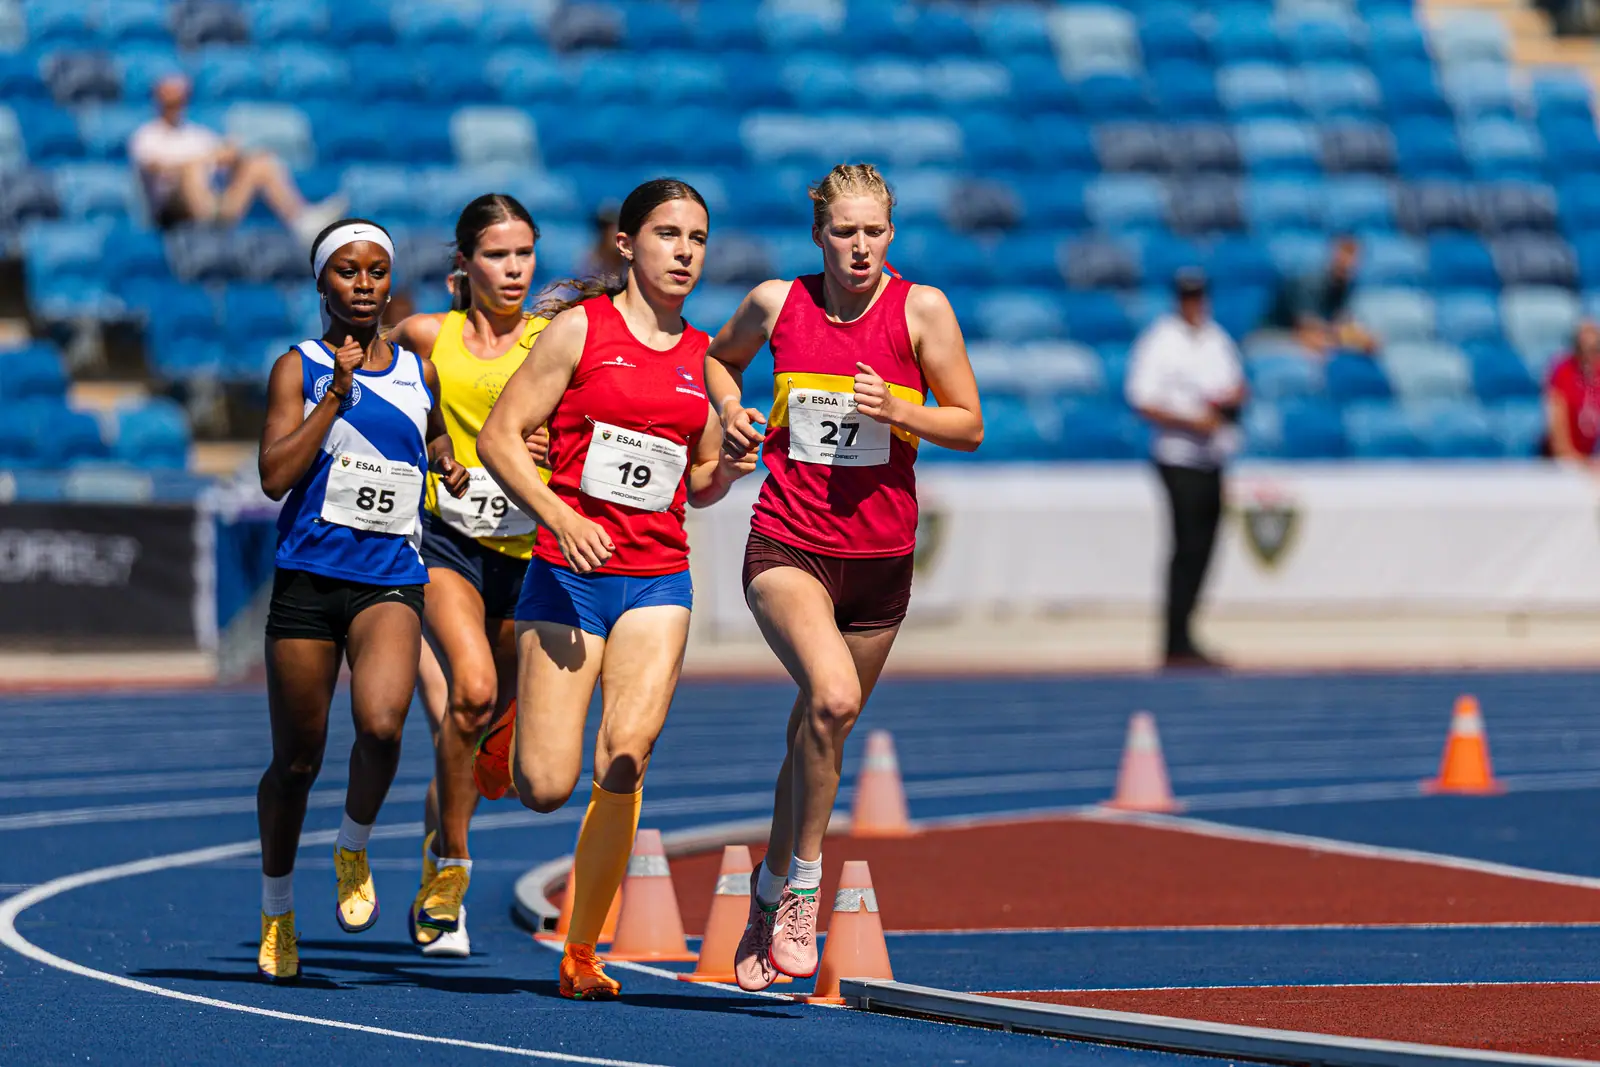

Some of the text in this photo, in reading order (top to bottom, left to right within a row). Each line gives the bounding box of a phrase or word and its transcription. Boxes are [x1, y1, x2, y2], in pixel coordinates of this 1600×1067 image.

[811, 396, 838, 406] ESAA
[616, 434, 642, 448] ESAA
[820, 420, 860, 447] 27
[355, 460, 382, 473] ESAA
[618, 461, 652, 489] 19
[356, 486, 396, 514] 85
[470, 495, 509, 518] 79
